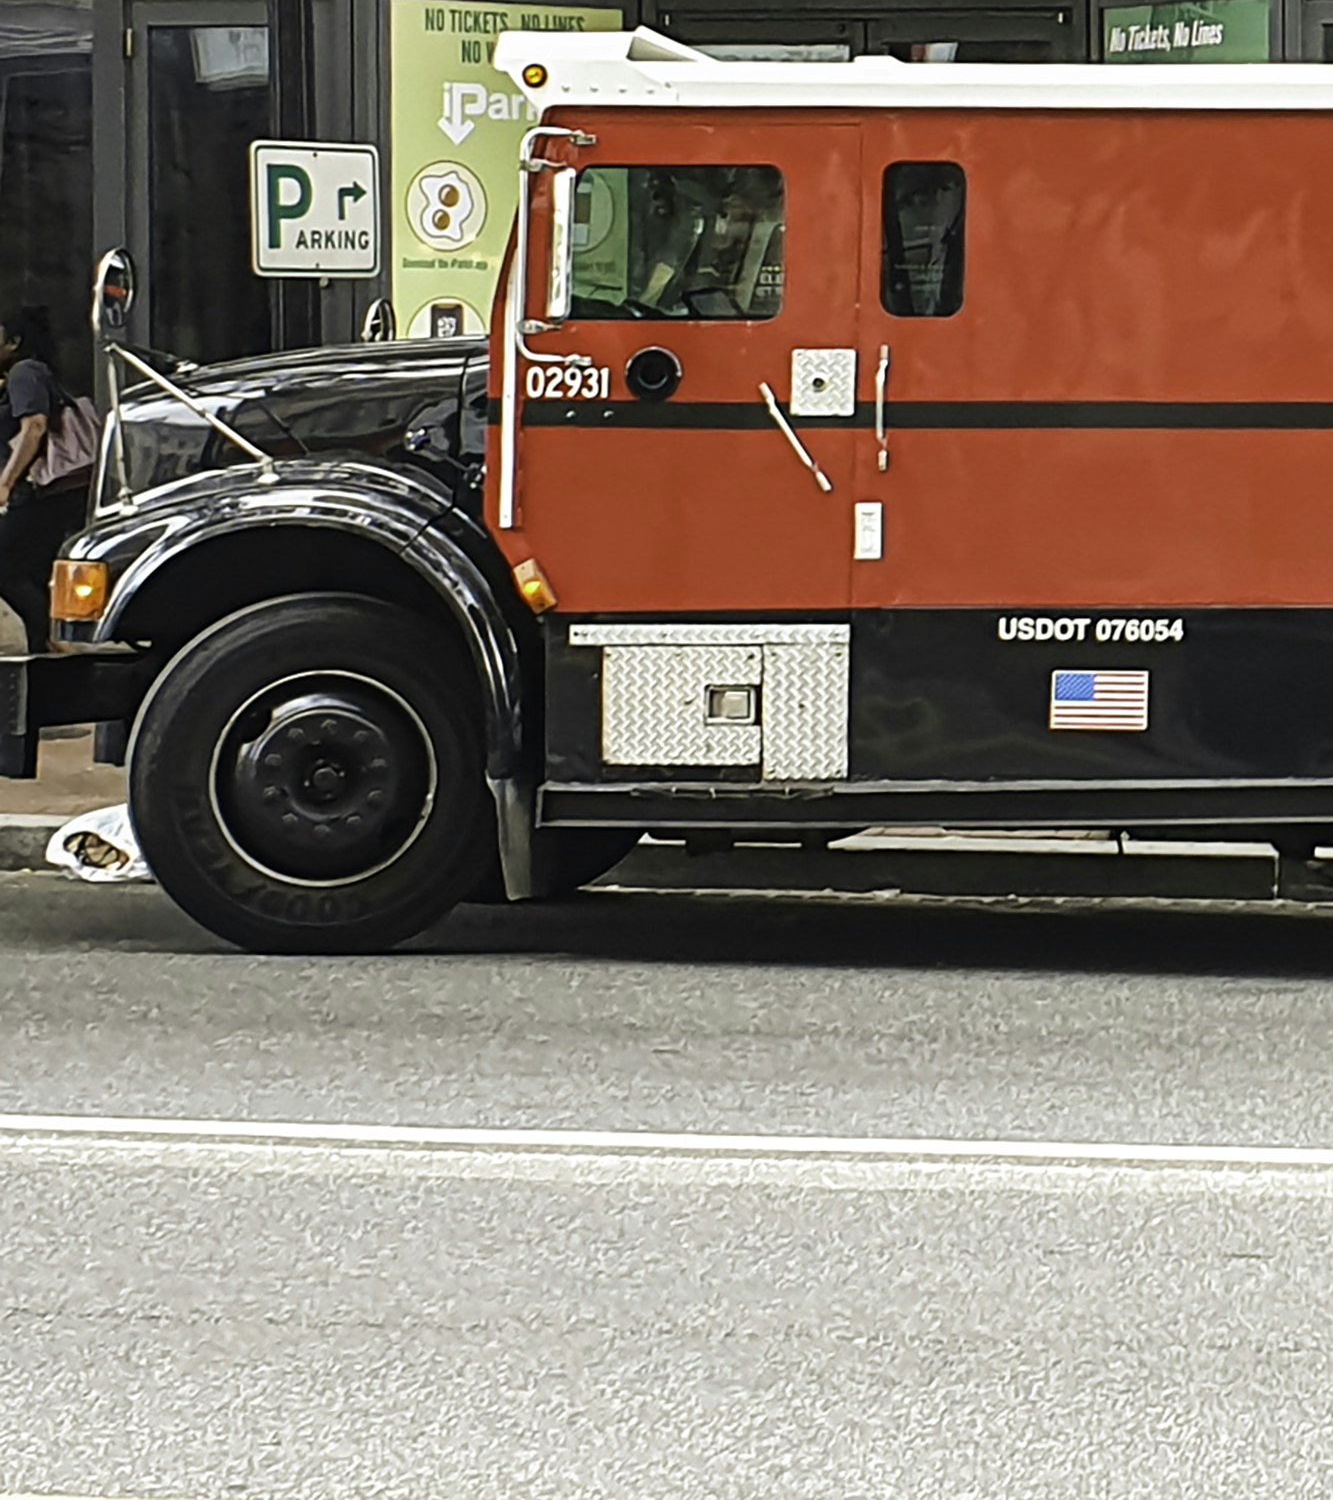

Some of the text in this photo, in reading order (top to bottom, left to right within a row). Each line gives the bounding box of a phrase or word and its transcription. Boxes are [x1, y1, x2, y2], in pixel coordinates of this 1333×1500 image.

[424, 8, 445, 32] NO
[1110, 19, 1223, 53] No Tickets, No Lines
[461, 39, 481, 64] NO
[525, 365, 610, 399] 02931
[998, 616, 1185, 643] USDOT 076054
